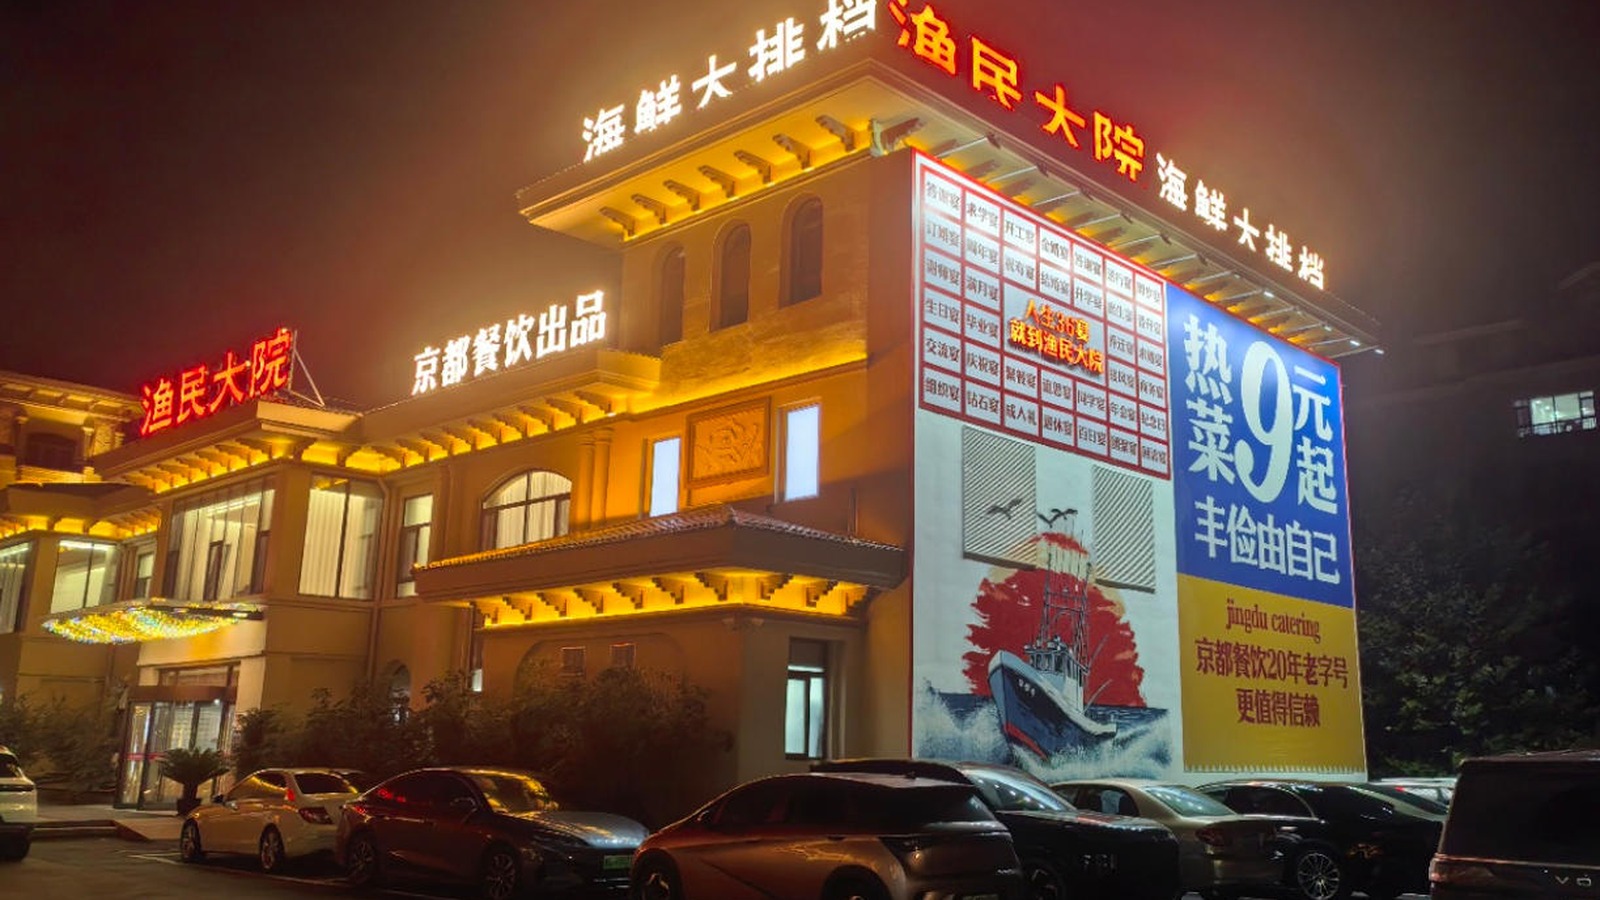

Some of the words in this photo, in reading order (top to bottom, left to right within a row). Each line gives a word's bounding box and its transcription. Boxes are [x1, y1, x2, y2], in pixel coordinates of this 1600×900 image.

[582, 0, 878, 163] 海鲜大排档
[888, 0, 1147, 182] 渔民大院
[1156, 152, 1325, 290] 海鲜大排档
[411, 289, 607, 395] 京都餐饮出品
[925, 296, 959, 326] 生日宴
[925, 336, 959, 364] 交流宴
[966, 312, 999, 340] 毕业宴
[1008, 317, 1105, 374] 就到渔民大院
[139, 327, 291, 435] 渔民大院
[1183, 313, 1236, 485] 热菜
[1234, 341, 1294, 503] 9
[1293, 365, 1338, 514] 元起
[1194, 495, 1341, 585] 丰俭由自己
[1195, 637, 1349, 689] 京都餐饮20年老字号
[1226, 598, 1269, 633] jingdu
[1271, 612, 1322, 645] catering
[1236, 688, 1321, 728] 更值得信赖
